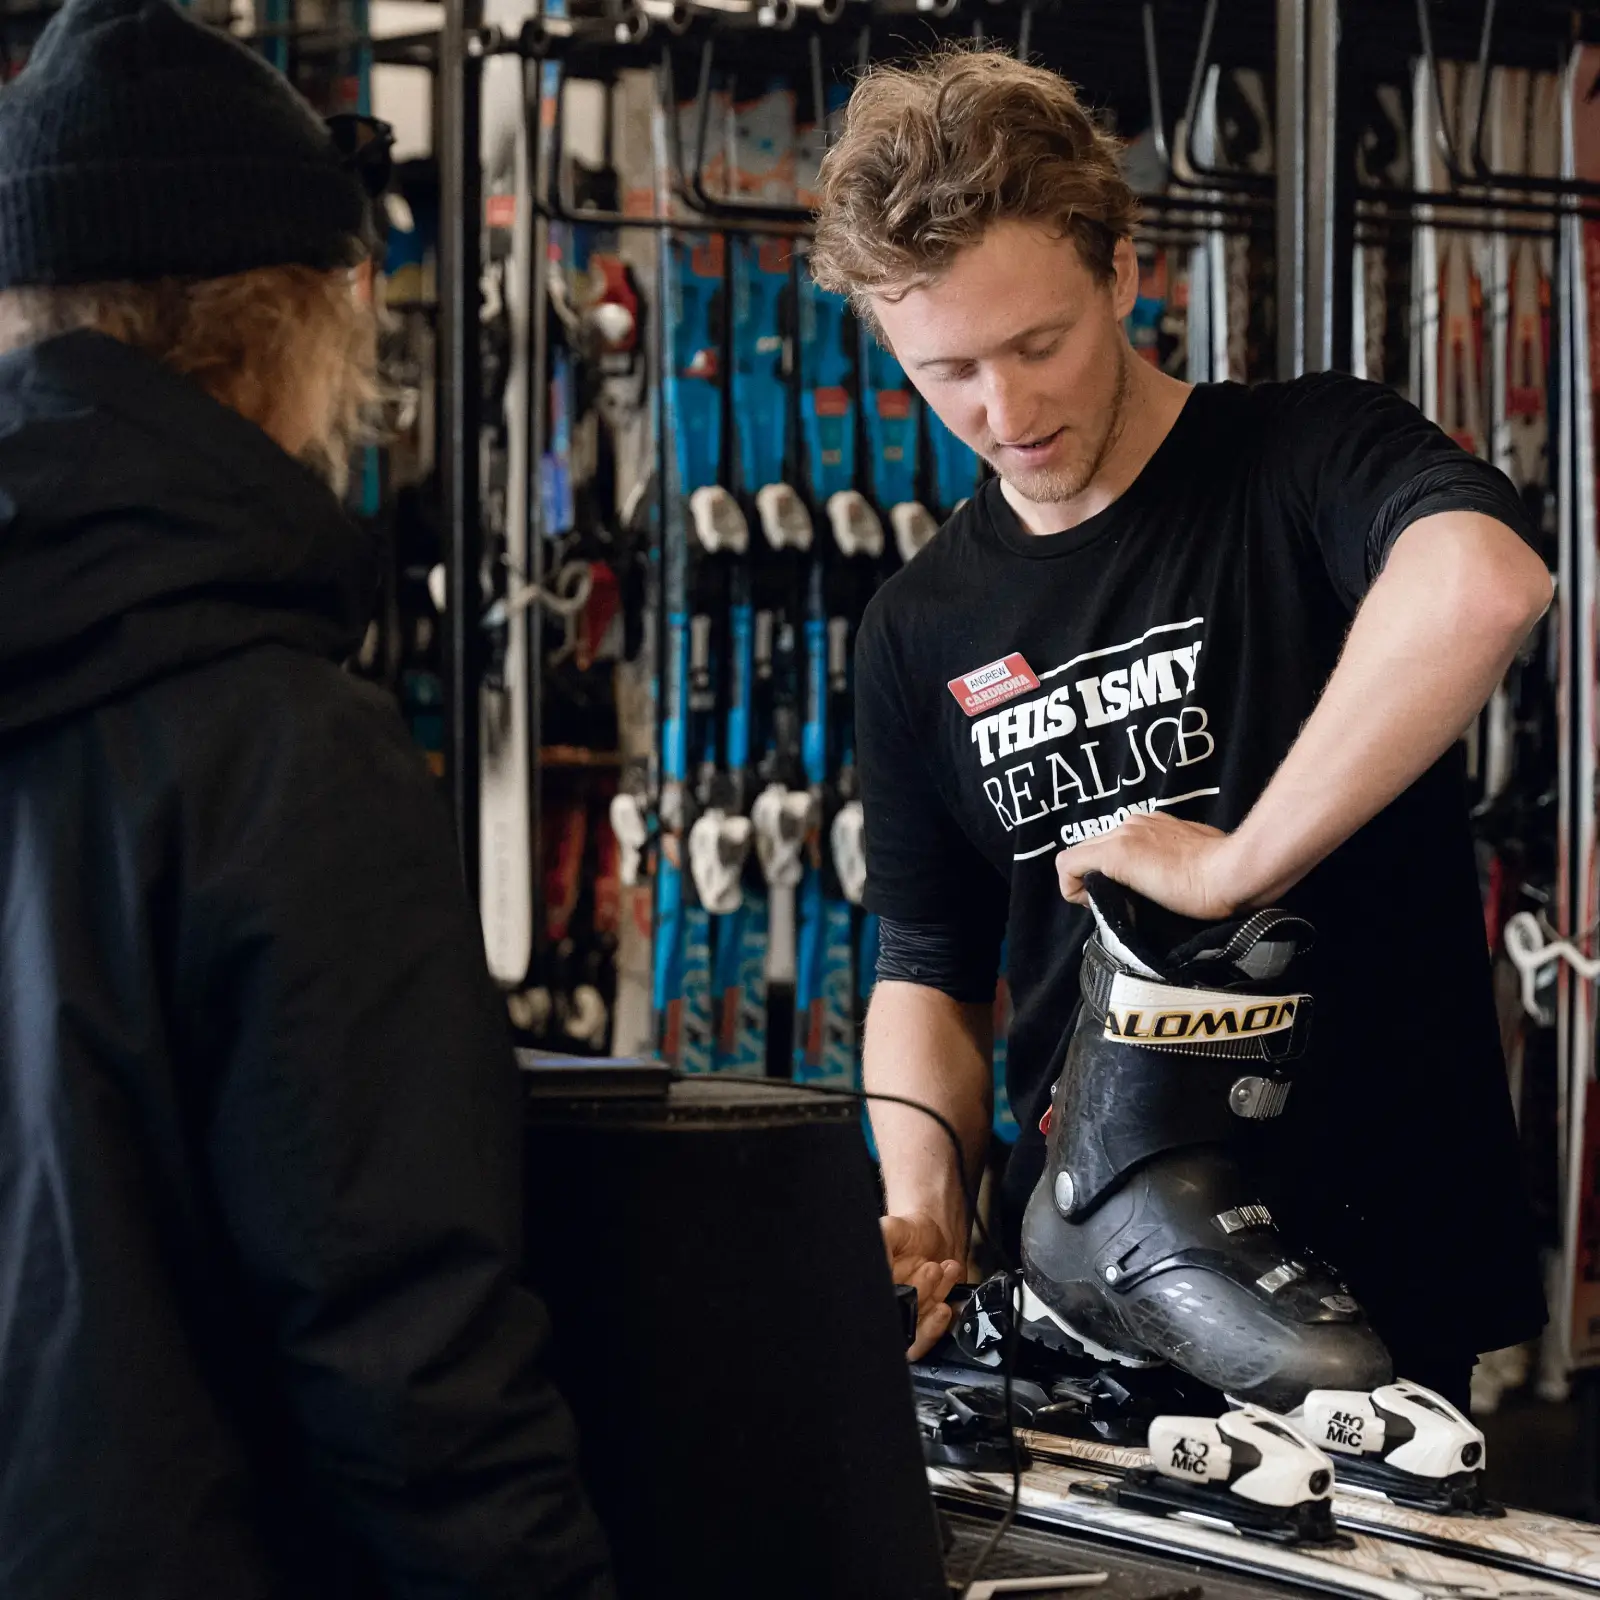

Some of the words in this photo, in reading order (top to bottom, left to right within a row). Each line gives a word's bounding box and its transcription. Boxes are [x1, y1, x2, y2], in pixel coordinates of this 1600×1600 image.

[964, 674, 1030, 708] CARDRONA
[969, 666, 1007, 689] ANDREW
[971, 686, 1077, 767] THIS
